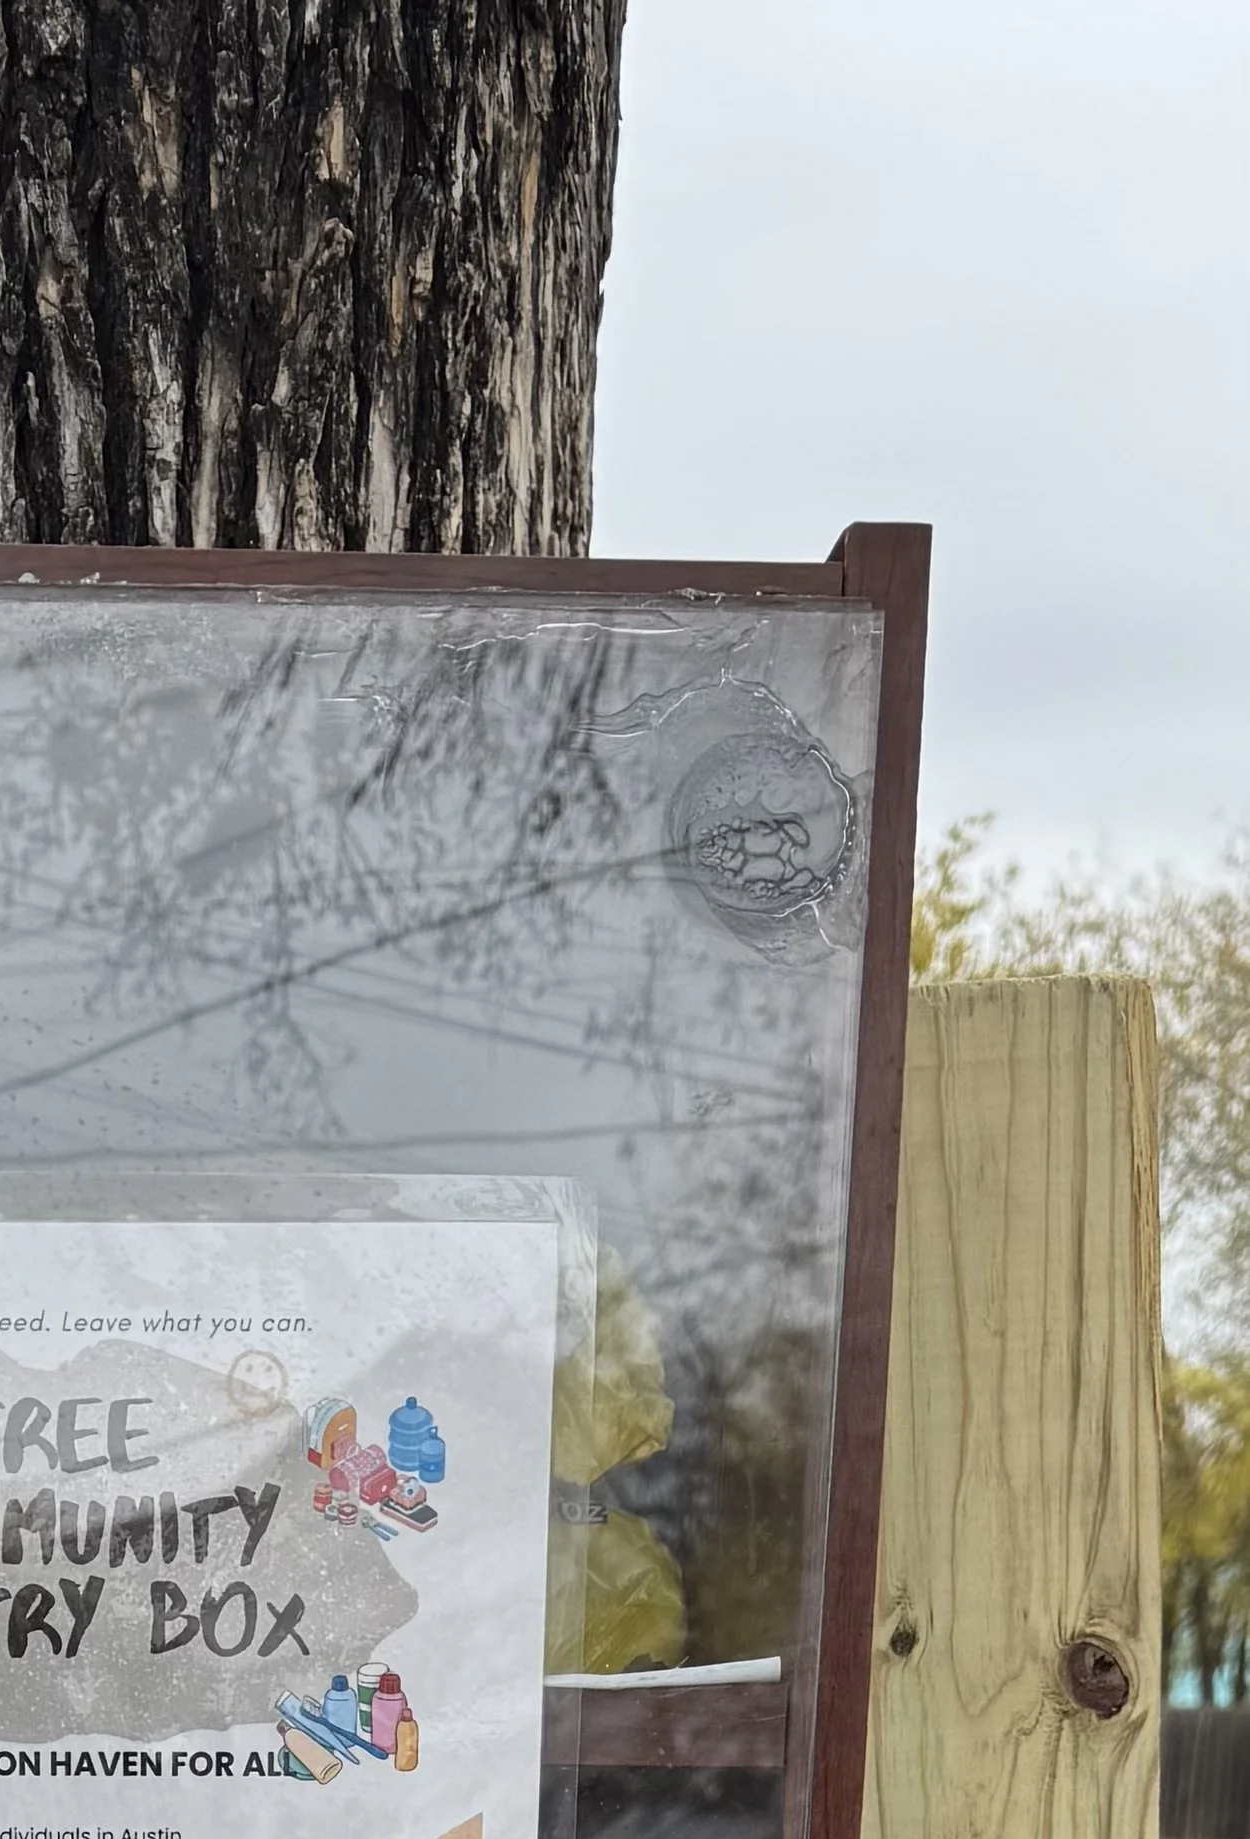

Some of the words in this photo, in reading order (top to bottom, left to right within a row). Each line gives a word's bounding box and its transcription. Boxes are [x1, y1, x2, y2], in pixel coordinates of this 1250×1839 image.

[62, 1311, 132, 1333] Leave
[142, 1311, 202, 1333] what
[211, 1316, 253, 1338] you
[261, 1316, 313, 1333] can.
[150, 1580, 310, 1656] BOX
[50, 1750, 164, 1778] HAVEN
[171, 1751, 234, 1778] FOR
[242, 1751, 297, 1778] ALL
